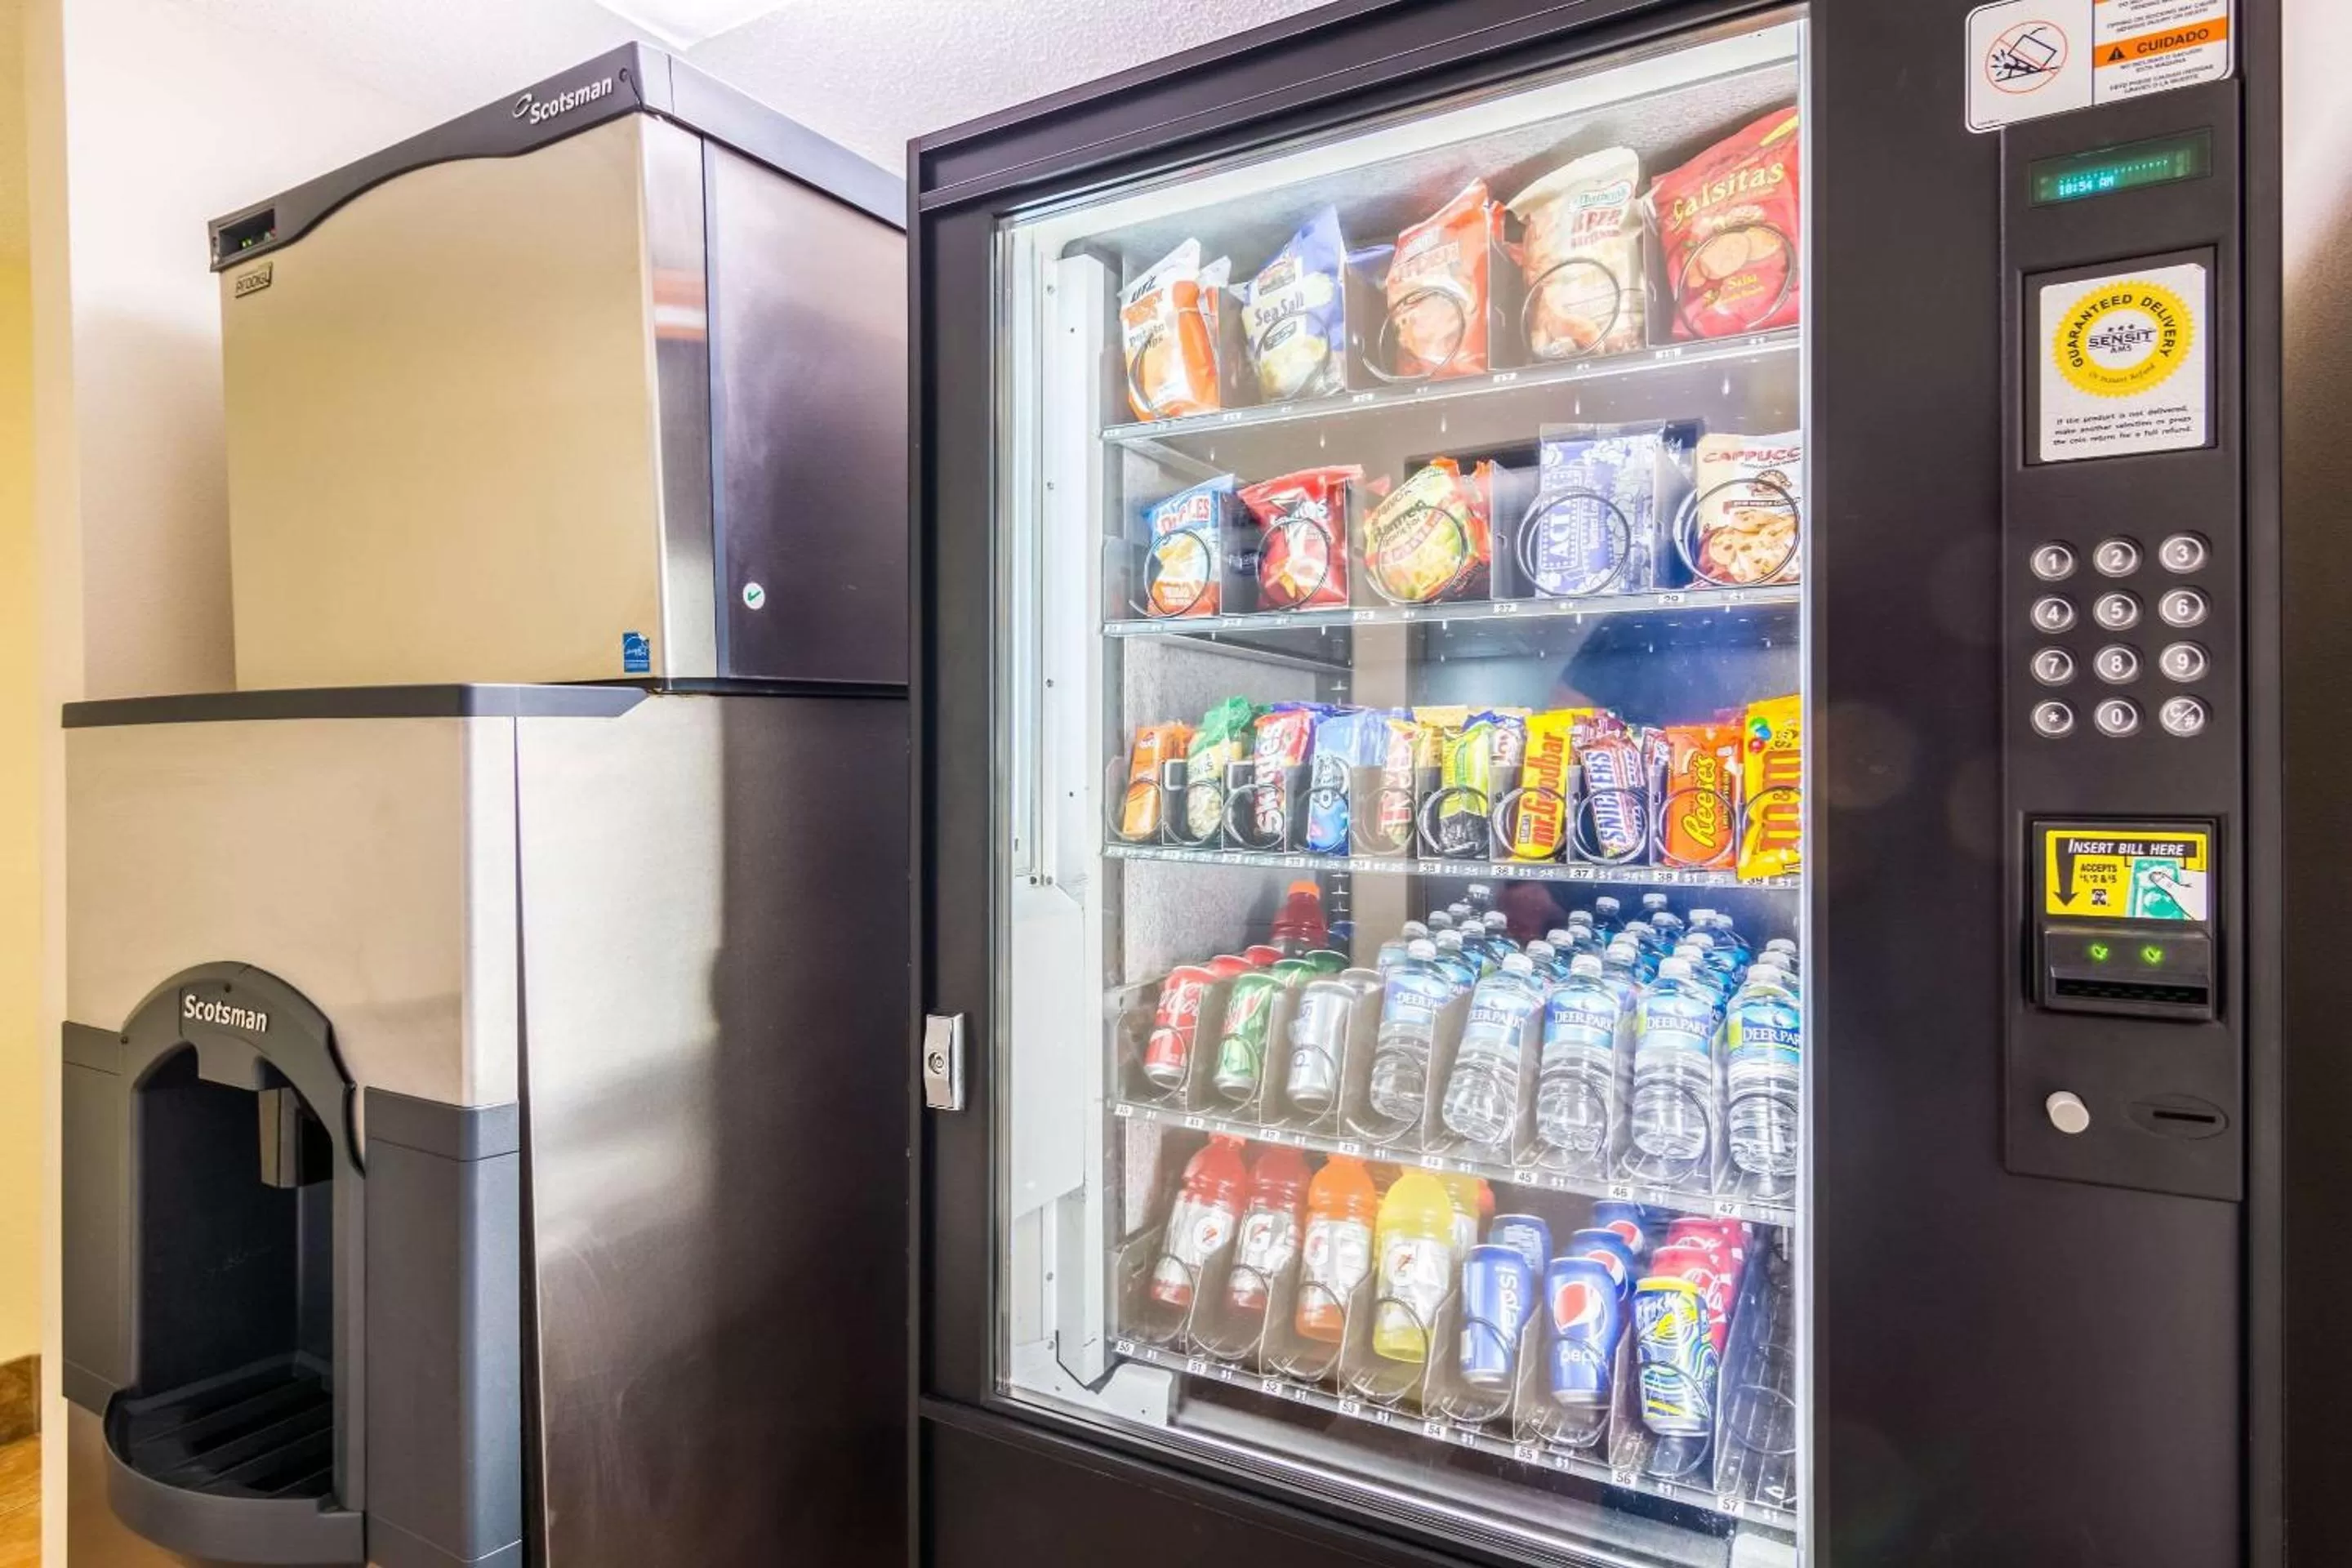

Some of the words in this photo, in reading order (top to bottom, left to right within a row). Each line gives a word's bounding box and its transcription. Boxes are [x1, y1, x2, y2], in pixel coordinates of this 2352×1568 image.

[2136, 29, 2209, 54] CUIDADO
[530, 77, 612, 124] Scotsman
[2067, 294, 2133, 368] GUARANTEED
[2140, 296, 2176, 358] DELIVERY
[2088, 331, 2152, 347] SENSIT
[2110, 345, 2132, 354] AMS
[2083, 413, 2115, 423] product
[2080, 424, 2112, 432] another
[2145, 429, 2158, 437] full
[2047, 554, 2057, 570] 1
[2110, 549, 2123, 566] 2
[2176, 545, 2189, 563] 3
[2047, 605, 2060, 621] 4
[2110, 602, 2123, 618] 5
[2176, 599, 2189, 616] 6
[2047, 657, 2060, 674] 7
[2110, 655, 2123, 672] 8
[2176, 653, 2189, 670] 9
[2111, 708, 2123, 725] 0
[1681, 755, 1716, 848] Reese's
[2068, 839, 2114, 854] INSERT
[2118, 842, 2145, 855] BILL
[2149, 844, 2185, 856] HERE
[1575, 870, 1589, 878] 37
[1658, 872, 1673, 881] 38
[2080, 864, 2118, 873] ACCEPTS
[184, 994, 268, 1032] Scotsman
[1555, 1011, 1584, 1022] DEER
[1587, 1014, 1614, 1031] PARK
[1648, 1016, 1679, 1030] DEER
[1681, 1018, 1709, 1037] PARK
[1743, 1028, 1779, 1041] DEER
[1780, 1031, 1801, 1045] PAR
